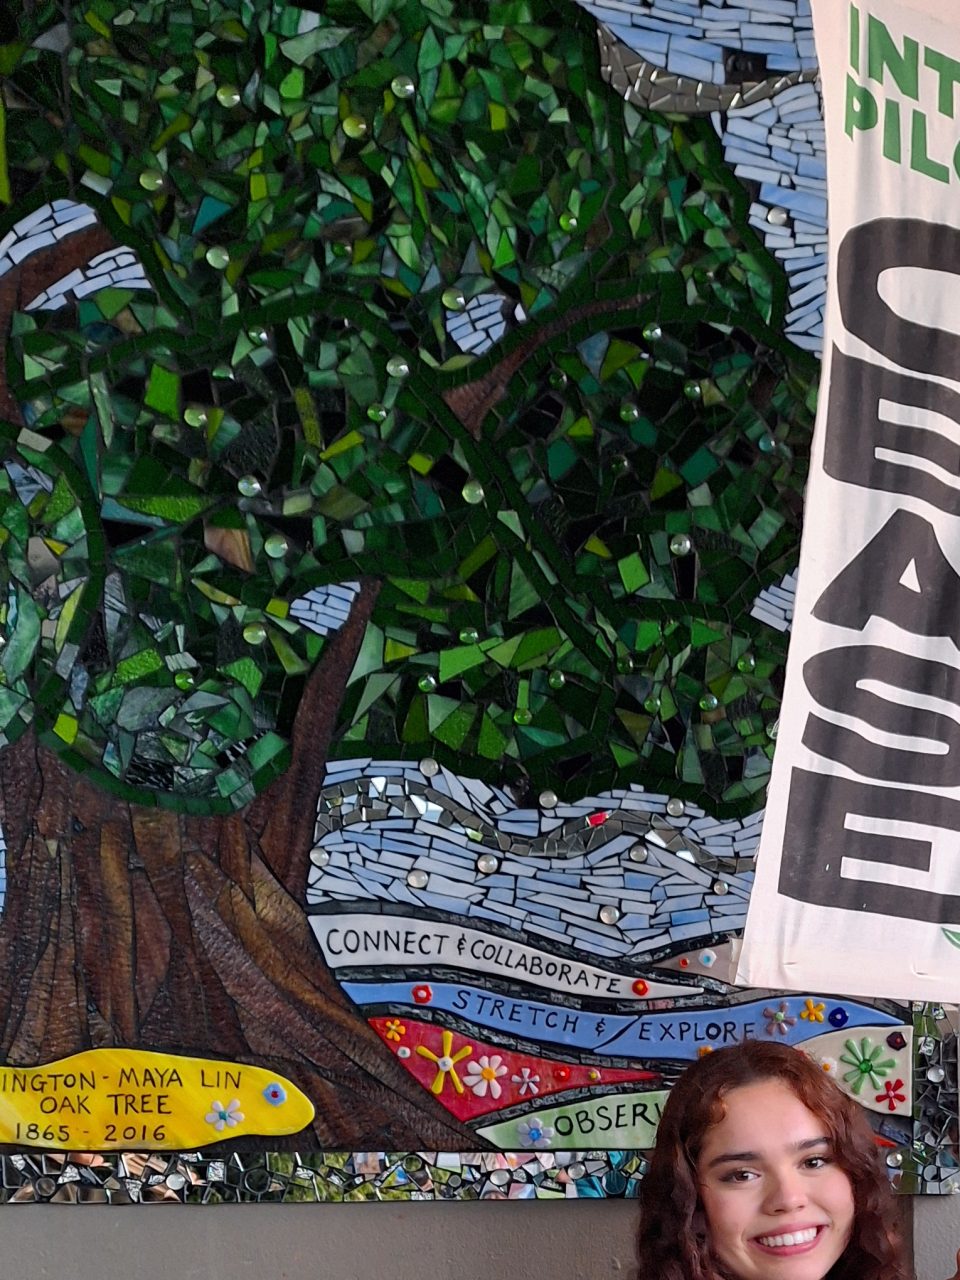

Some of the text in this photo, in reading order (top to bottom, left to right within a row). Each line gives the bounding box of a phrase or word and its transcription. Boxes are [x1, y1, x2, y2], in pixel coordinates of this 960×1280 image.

[326, 928, 621, 995] CONNECT & COLLABORATE
[452, 989, 579, 1033] STRETCH
[118, 1068, 184, 1088] MAYA
[201, 1069, 241, 1089] LIN
[40, 1093, 172, 1116] OAK TREE
[16, 1122, 70, 1142] 1865
[104, 1124, 166, 1142] 2016
